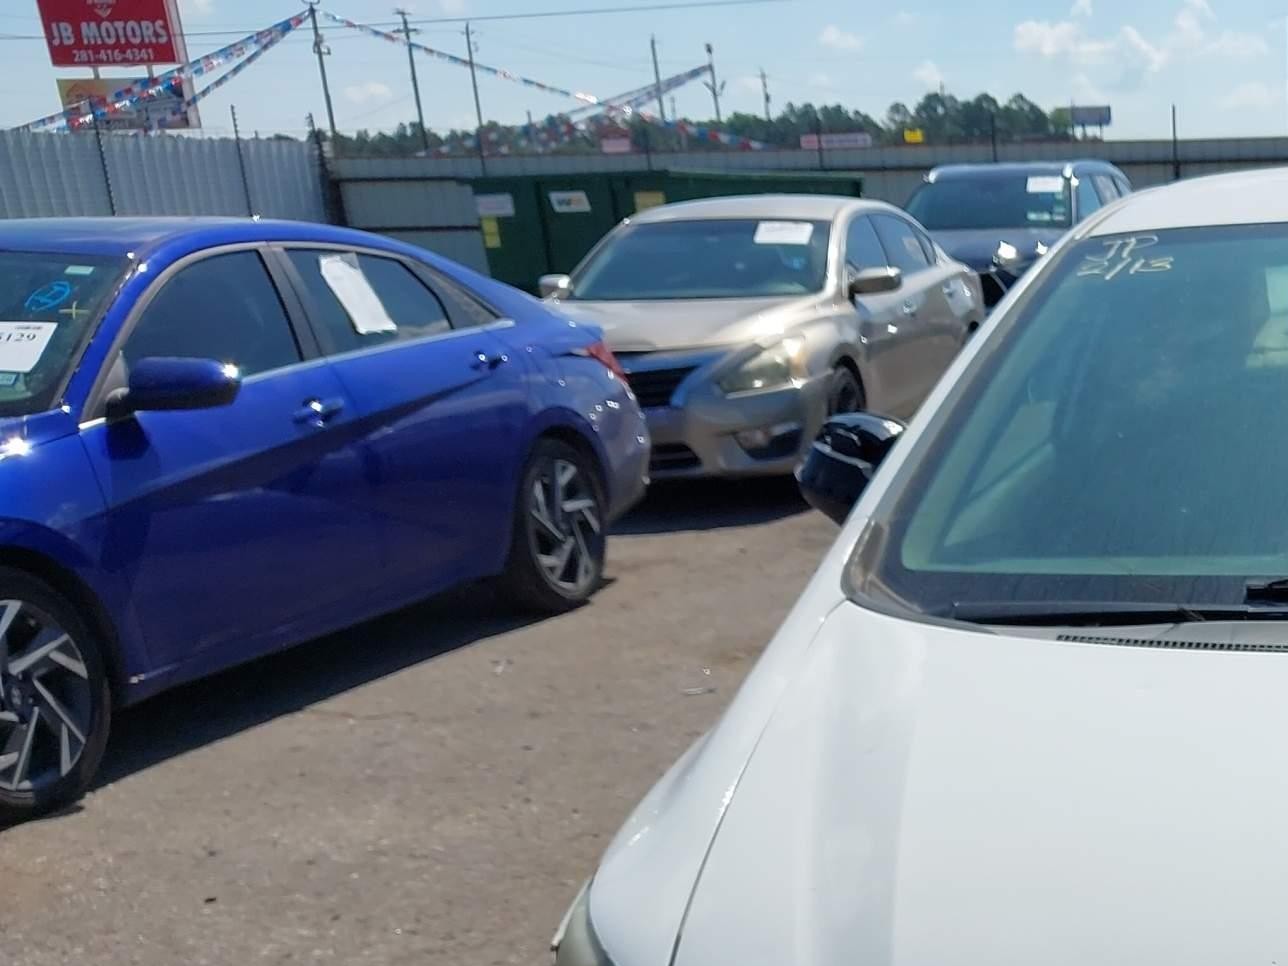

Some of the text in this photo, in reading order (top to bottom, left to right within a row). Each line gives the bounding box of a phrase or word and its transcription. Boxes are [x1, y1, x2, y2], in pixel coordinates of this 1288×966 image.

[51, 20, 169, 46] JB MOTORS
[72, 48, 155, 63] 281-416-4341
